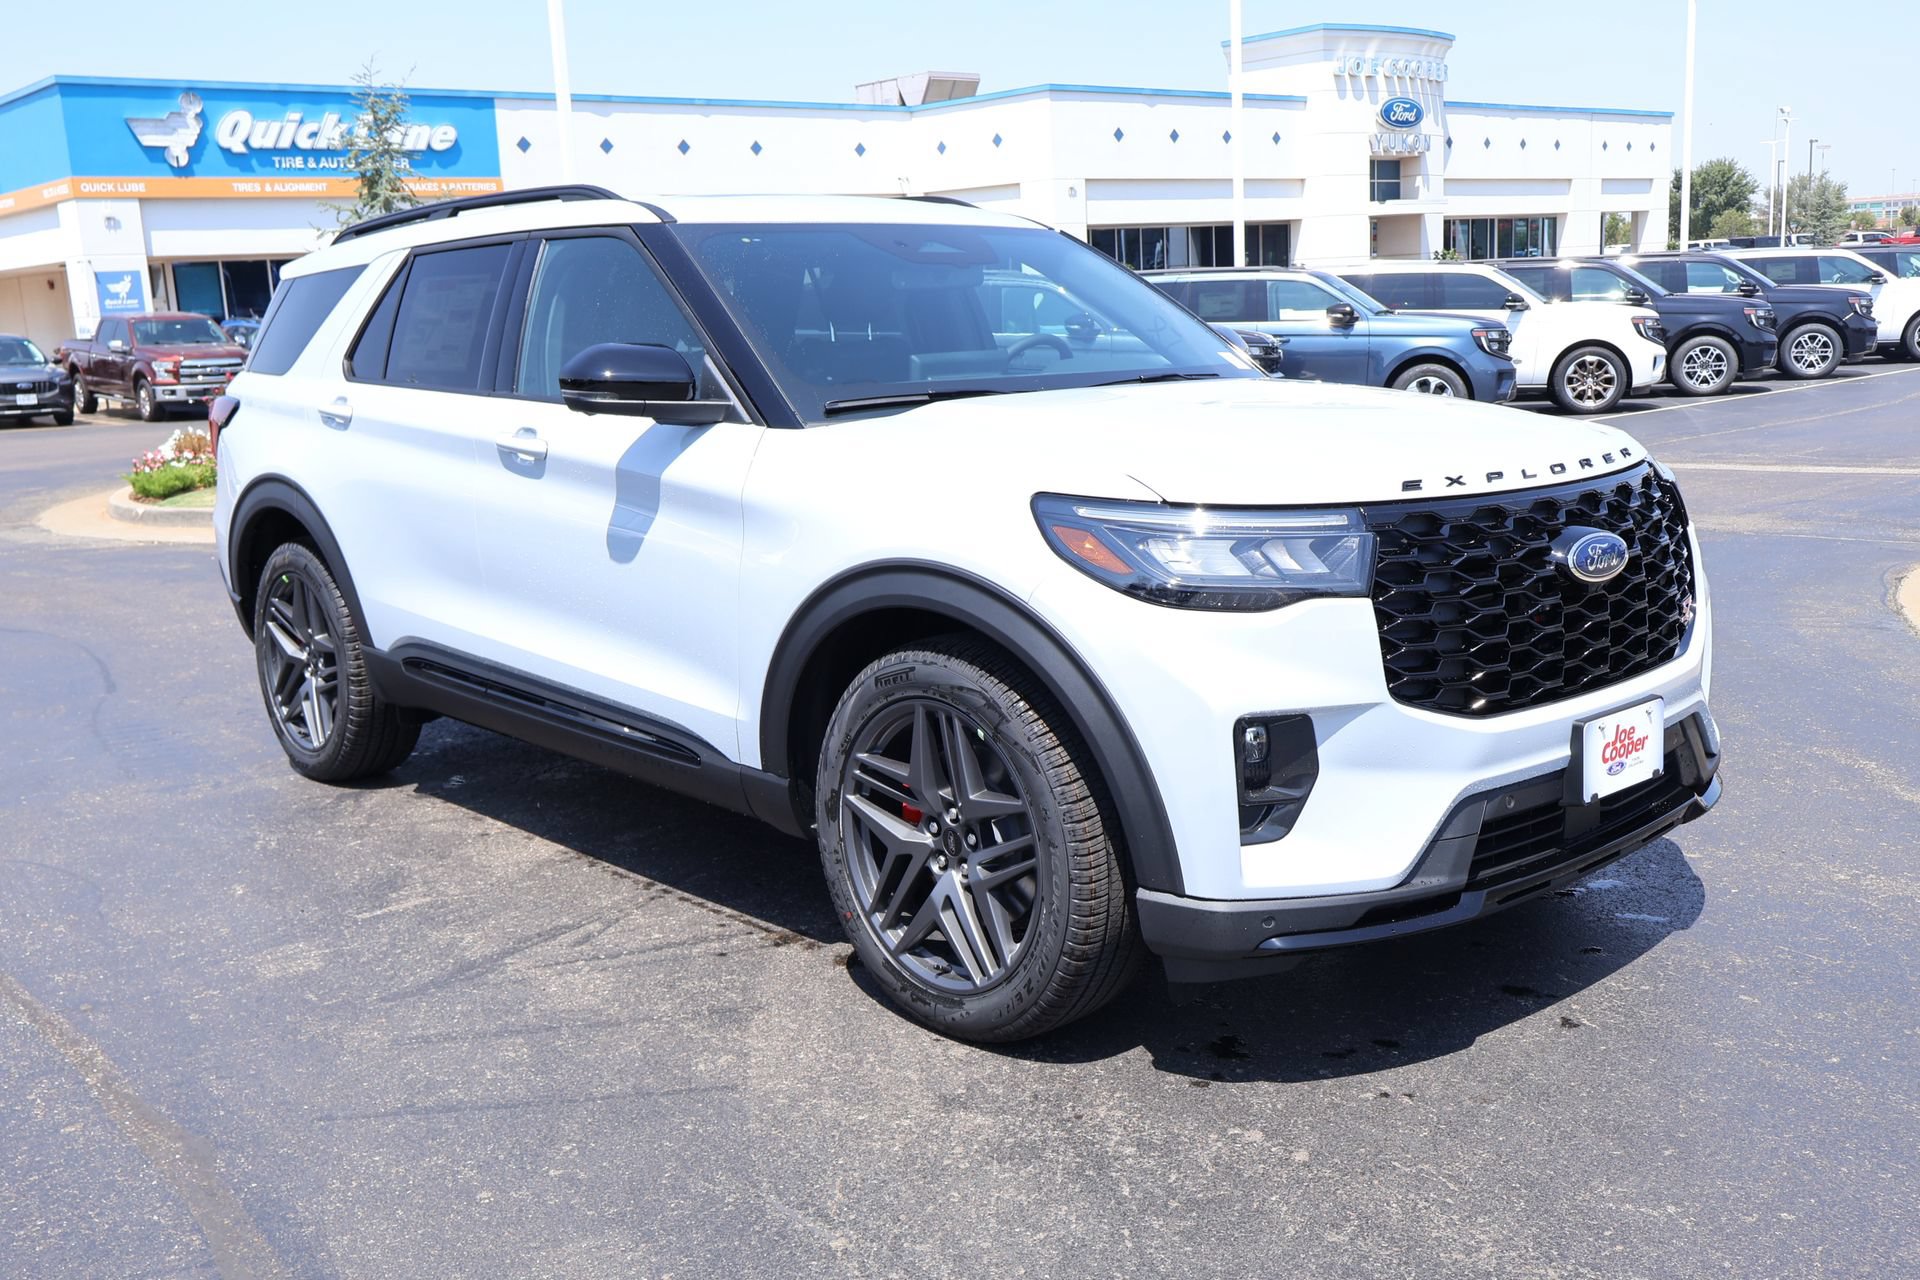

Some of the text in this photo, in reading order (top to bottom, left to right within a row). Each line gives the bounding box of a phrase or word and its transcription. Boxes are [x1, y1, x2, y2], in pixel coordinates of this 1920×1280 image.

[1335, 56, 1448, 82] JOE COOPER
[1390, 102, 1417, 122] Ford
[215, 109, 350, 154] Quick
[1370, 134, 1431, 152] YUKON
[272, 156, 304, 168] TIRE
[307, 156, 316, 168] &
[319, 156, 356, 169] AUTO
[80, 182, 115, 192] QUICK
[117, 182, 146, 192] LUBE
[232, 182, 261, 192] TIRES
[273, 182, 327, 192] ALIGNMENT
[1402, 447, 1632, 491] EXPLORER
[1587, 543, 1619, 571] Ford
[1611, 724, 1635, 747] Joe
[1602, 735, 1648, 764] Cooper
